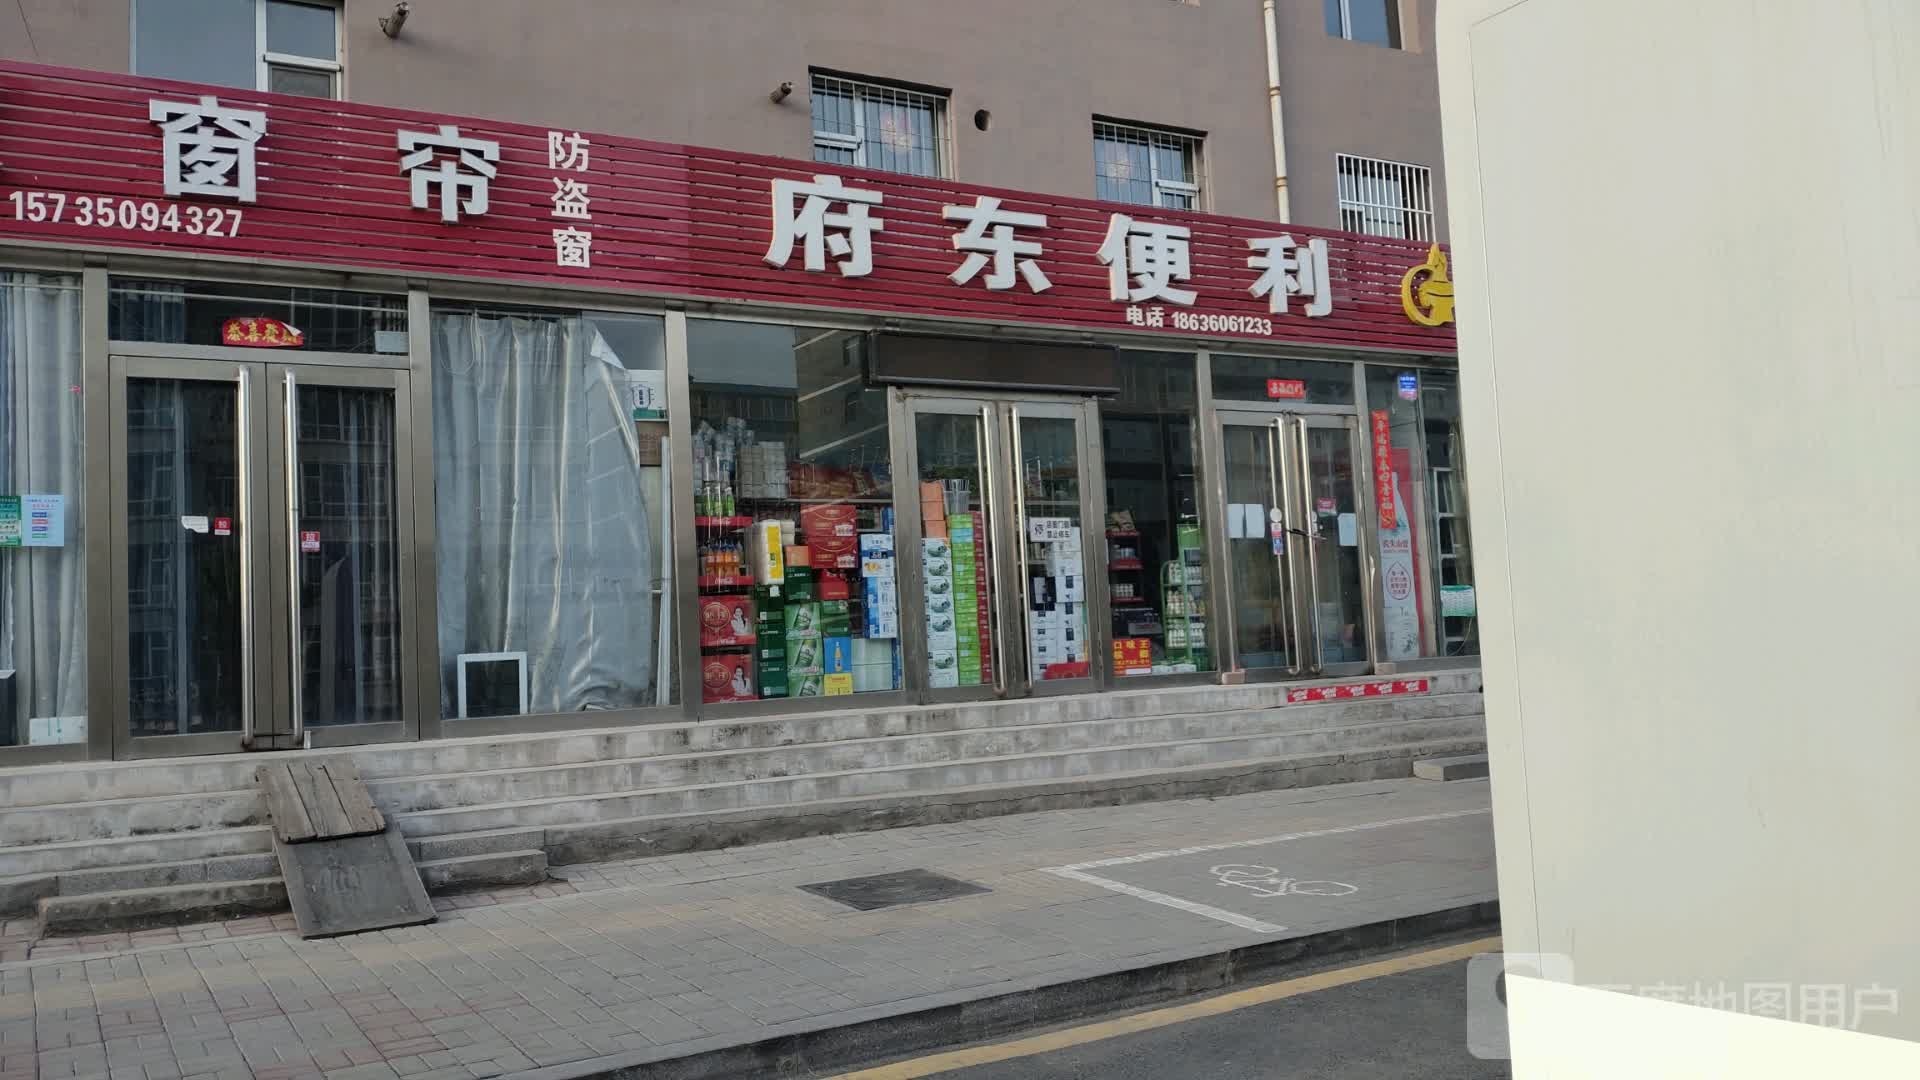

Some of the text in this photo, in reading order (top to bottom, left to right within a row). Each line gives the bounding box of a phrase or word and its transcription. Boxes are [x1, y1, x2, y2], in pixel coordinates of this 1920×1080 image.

[148, 95, 501, 224] 窗帘
[547, 130, 593, 269] 防盗窗
[763, 174, 1332, 317] 府东便利
[1126, 304, 1272, 337] 电话 18636061233
